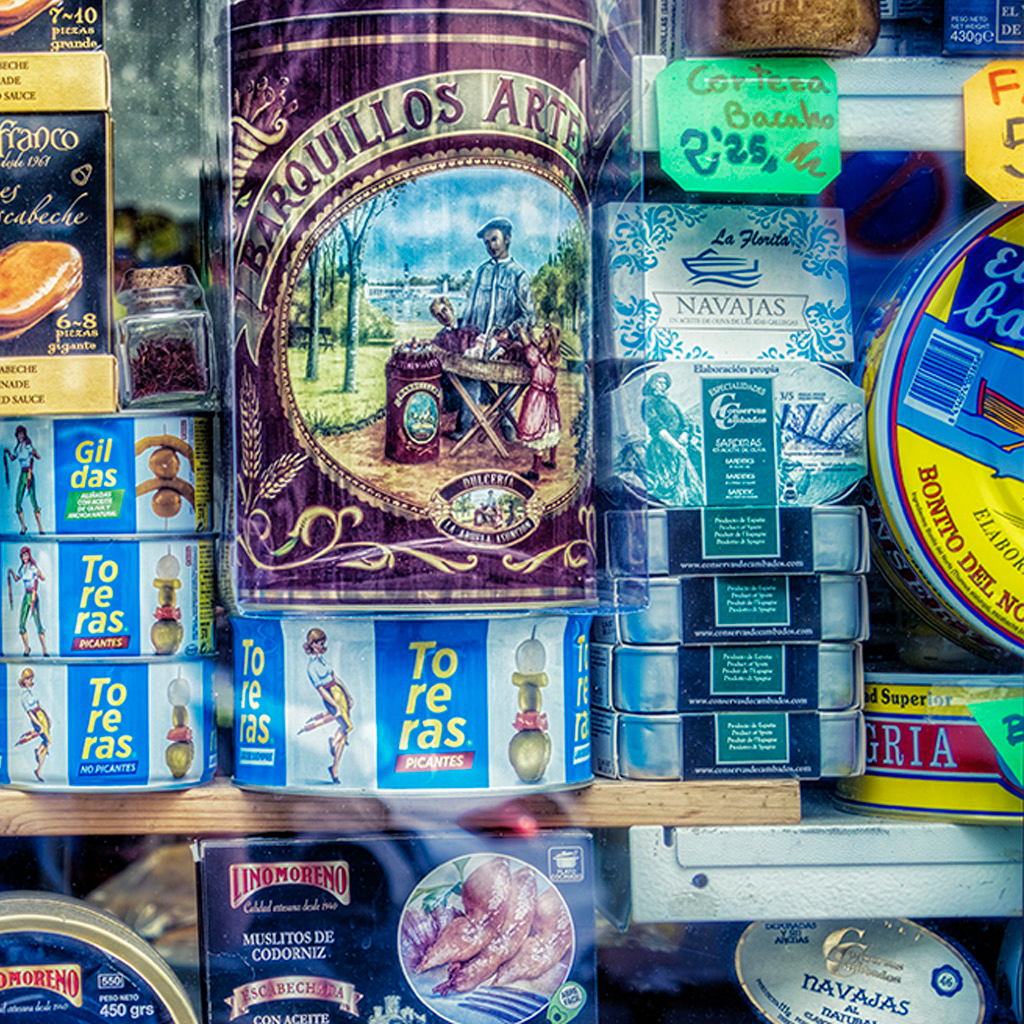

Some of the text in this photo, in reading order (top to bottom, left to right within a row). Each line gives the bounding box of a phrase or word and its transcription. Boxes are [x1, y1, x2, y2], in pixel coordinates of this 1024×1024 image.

[1002, 6, 1019, 16] EL
[1002, 24, 1021, 35] DE
[240, 82, 466, 276] BARQUILLOS
[711, 228, 792, 250] La Florita
[676, 296, 787, 318] NAVAJAS
[694, 364, 779, 375] Elaboración propia
[708, 382, 766, 396] ESPECIALIDADES
[75, 438, 112, 464] Gil
[70, 465, 117, 488] das
[918, 464, 965, 553] BONITO
[957, 551, 996, 599] DEL
[81, 553, 119, 584] To
[408, 640, 459, 681] To
[89, 676, 127, 708] To
[405, 681, 452, 715] re
[86, 709, 122, 734] re
[405, 754, 464, 770] PICANTES
[233, 865, 347, 903] LINOMORENO
[242, 930, 335, 946] MUSLITOS DE
[252, 946, 328, 961] CODORNIZ
[99, 993, 139, 1002] PESO NETO
[800, 973, 911, 1016] NAVAJAS
[99, 1004, 155, 1019] 450 grs
[253, 1012, 330, 1024] CON ACEITE
